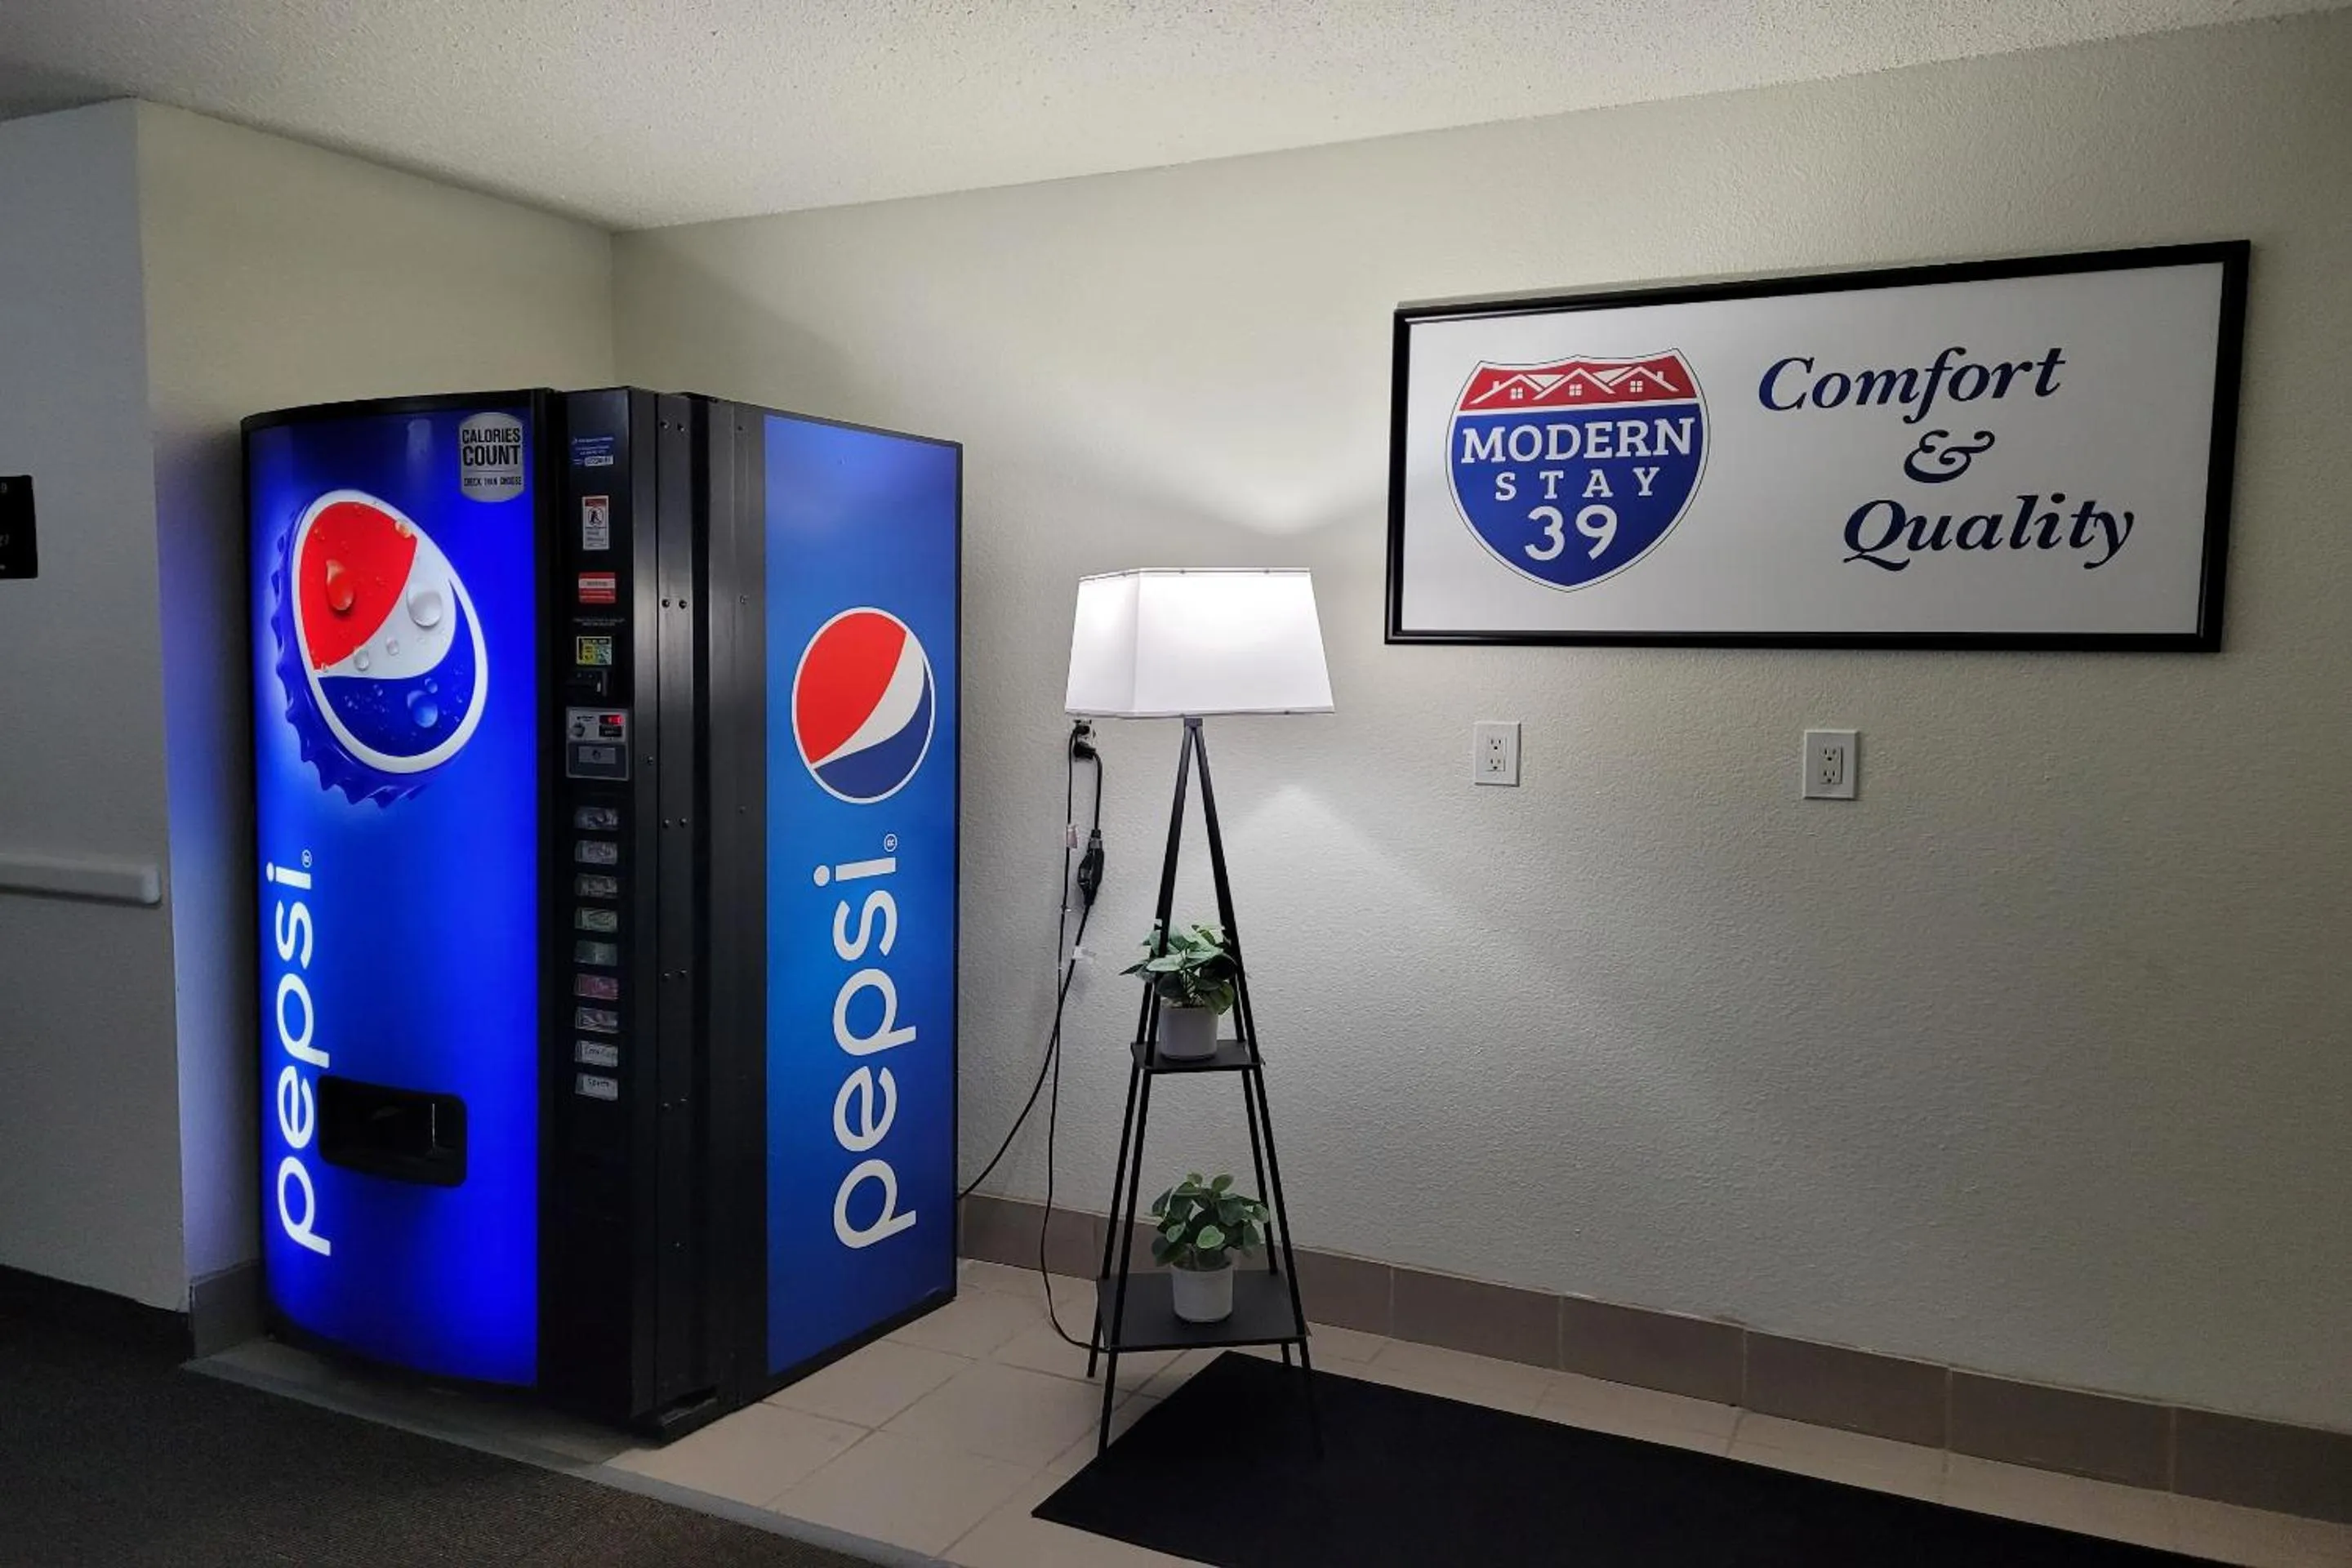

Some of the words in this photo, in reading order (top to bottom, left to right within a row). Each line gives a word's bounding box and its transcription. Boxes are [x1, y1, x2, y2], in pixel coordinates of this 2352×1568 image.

[1758, 346, 2066, 425] Comfort
[462, 428, 521, 443] CALORIES
[462, 445, 521, 466] COUNT
[1461, 417, 1695, 464] MODERN
[1903, 429, 1996, 484] &
[1494, 467, 1660, 501] STAY
[1524, 505, 1618, 561] 39
[1842, 492, 2135, 572] Quality
